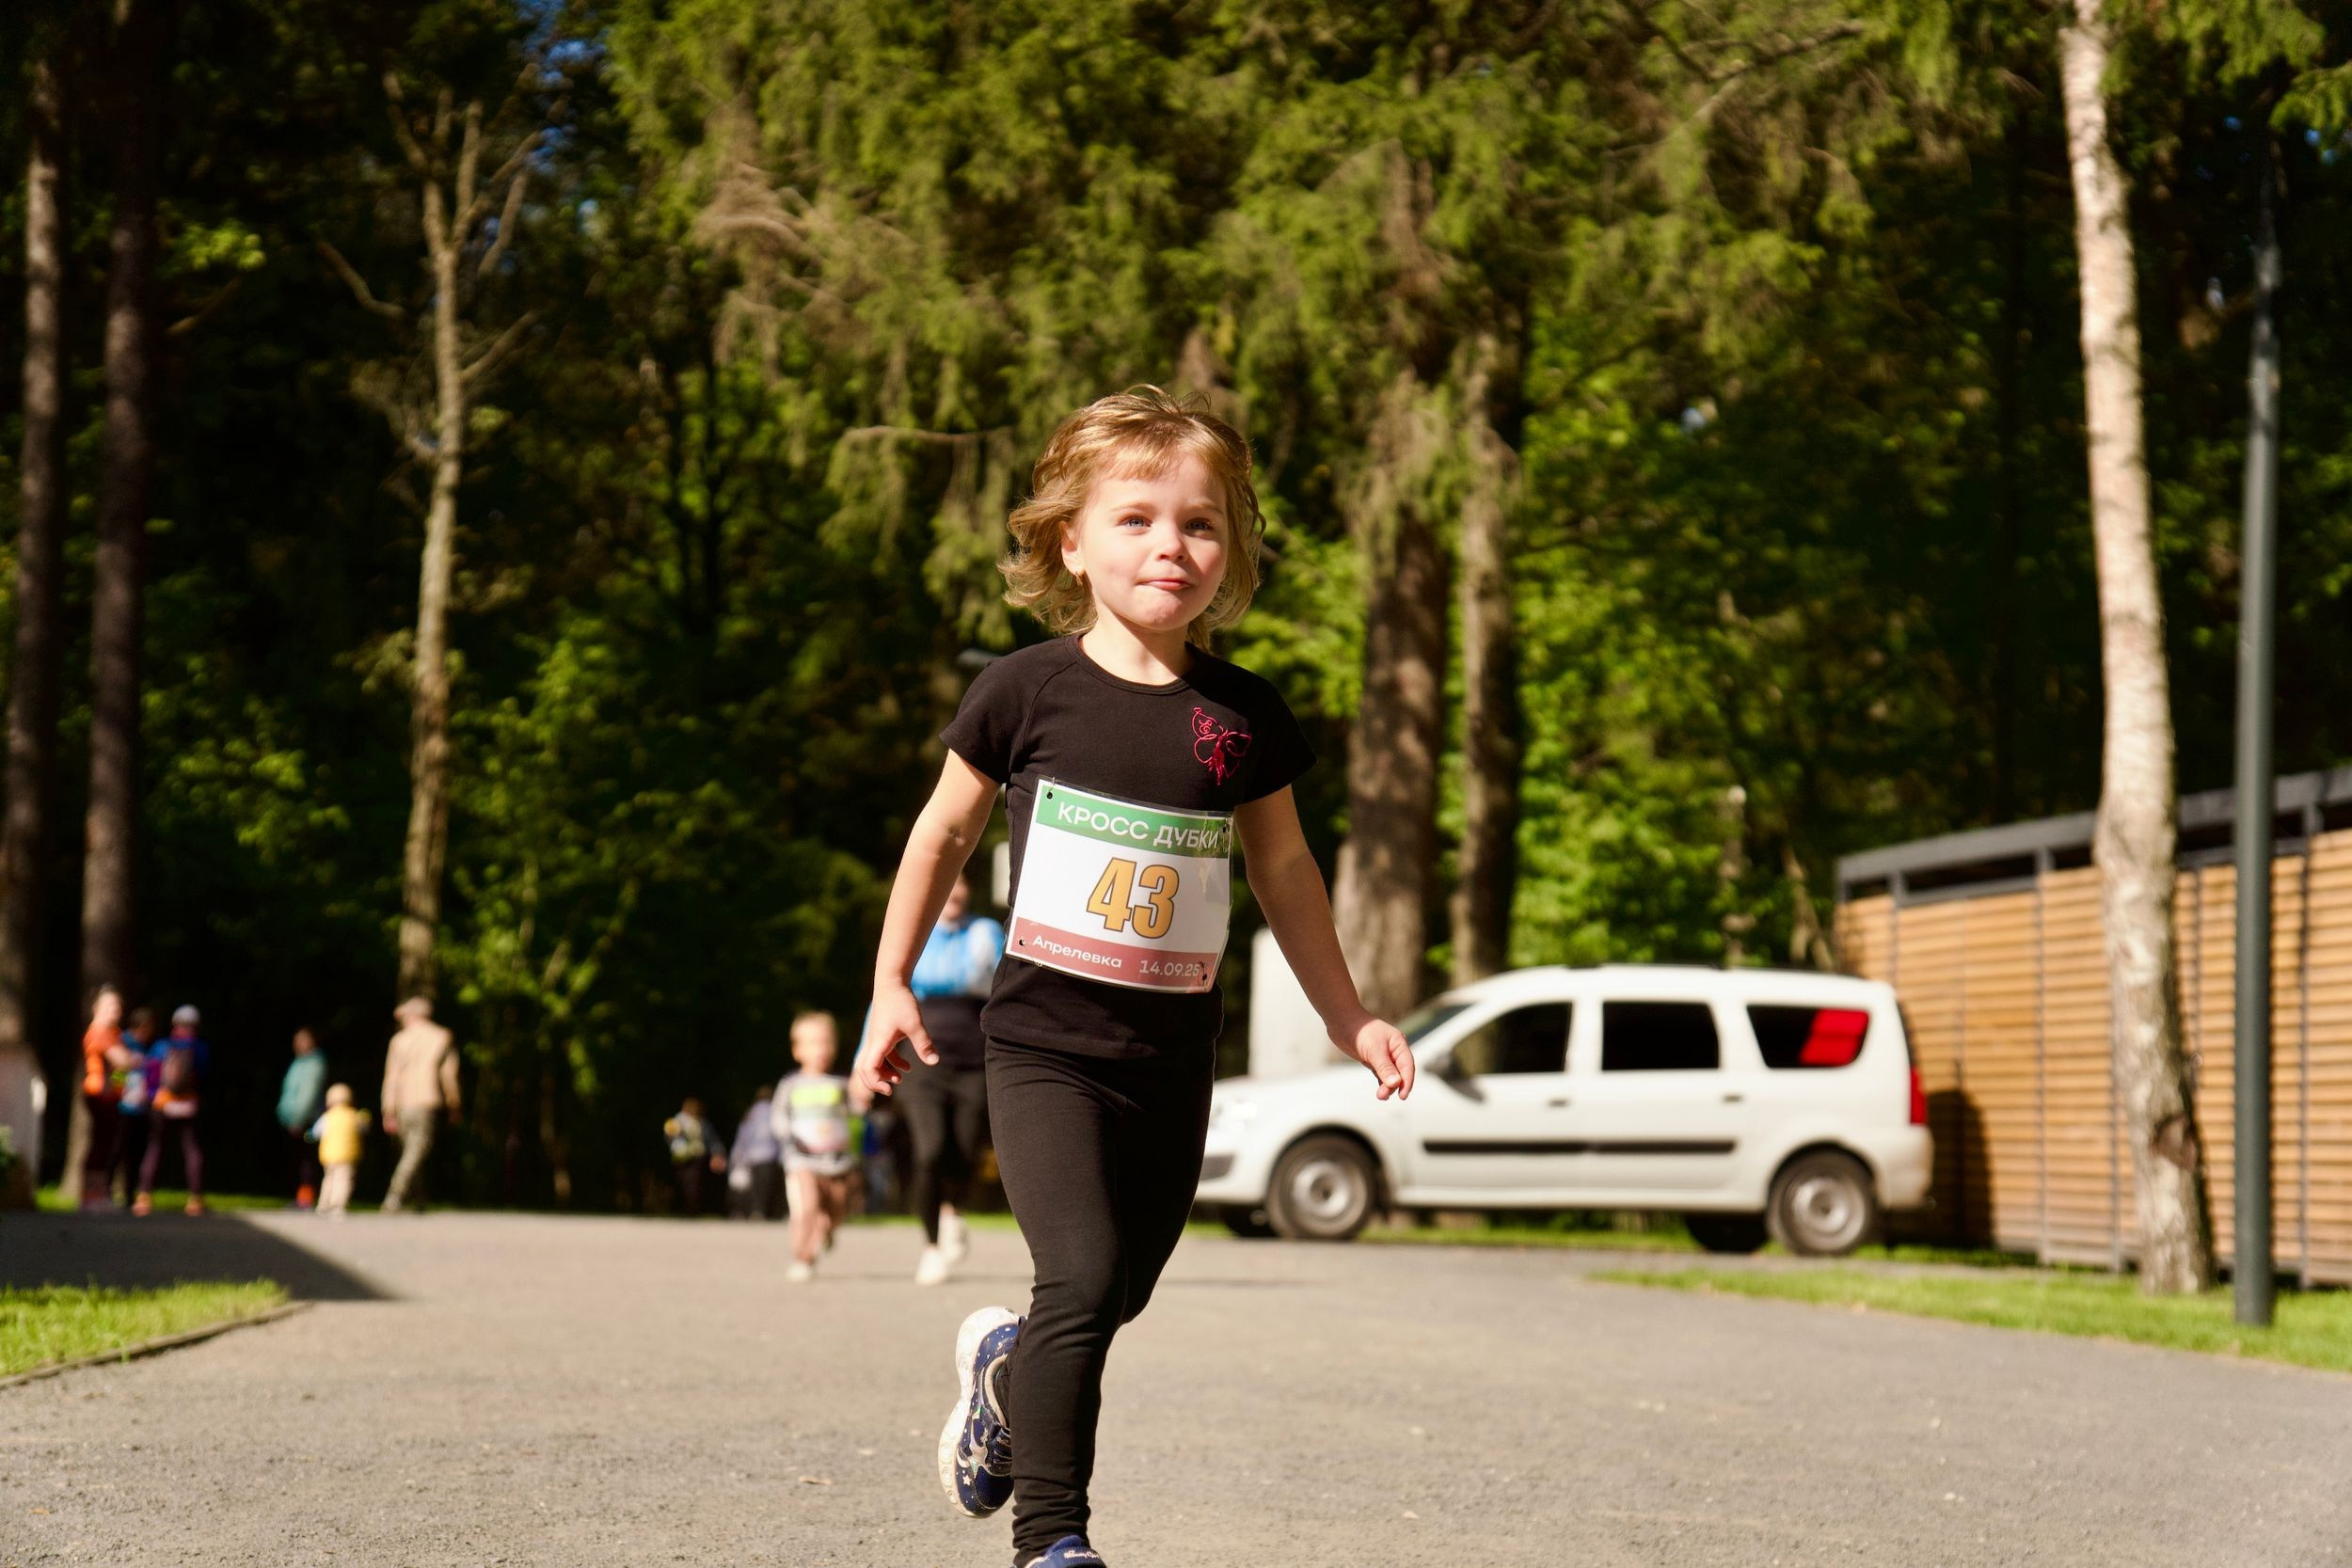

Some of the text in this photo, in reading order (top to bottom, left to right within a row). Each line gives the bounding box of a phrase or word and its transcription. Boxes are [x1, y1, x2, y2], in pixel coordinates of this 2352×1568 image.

[1057, 801, 1219, 848] КРОСС ДУБКИ
[1086, 857, 1180, 940] 43
[1032, 935, 1200, 977] Апрелевка 14.09.25
